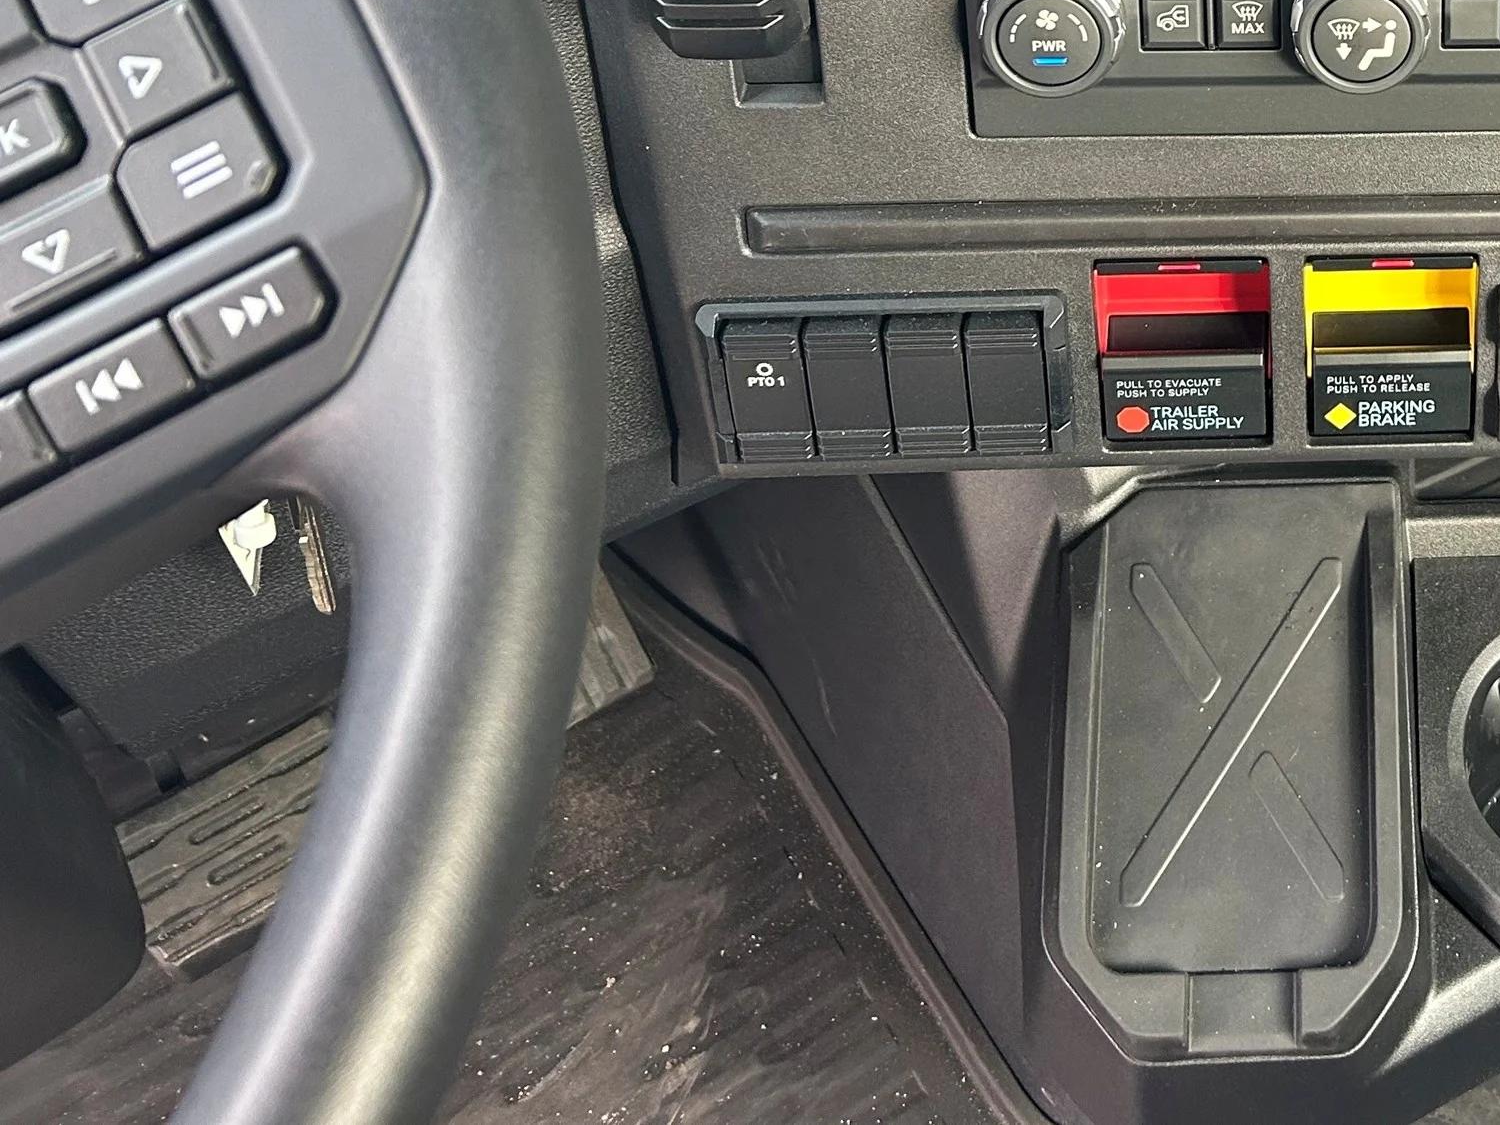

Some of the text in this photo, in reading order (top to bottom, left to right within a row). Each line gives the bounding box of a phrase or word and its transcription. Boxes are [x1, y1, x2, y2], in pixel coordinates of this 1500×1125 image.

[1231, 22, 1265, 35] MAX
[1032, 40, 1066, 52] PWR
[747, 375, 785, 387] PTO 1
[1116, 378, 1222, 389] PULL TO EVACUATE
[1326, 374, 1414, 385] PULL TO APPLY
[1117, 387, 1210, 398] PUSH TO SUPPLY
[1326, 382, 1431, 394] PUSH TO RELEASE
[1150, 405, 1219, 418] TRAILER
[1358, 400, 1435, 414] PARKING
[1151, 416, 1244, 431] AIR SUPPLY
[1358, 412, 1417, 427] BRAKE
